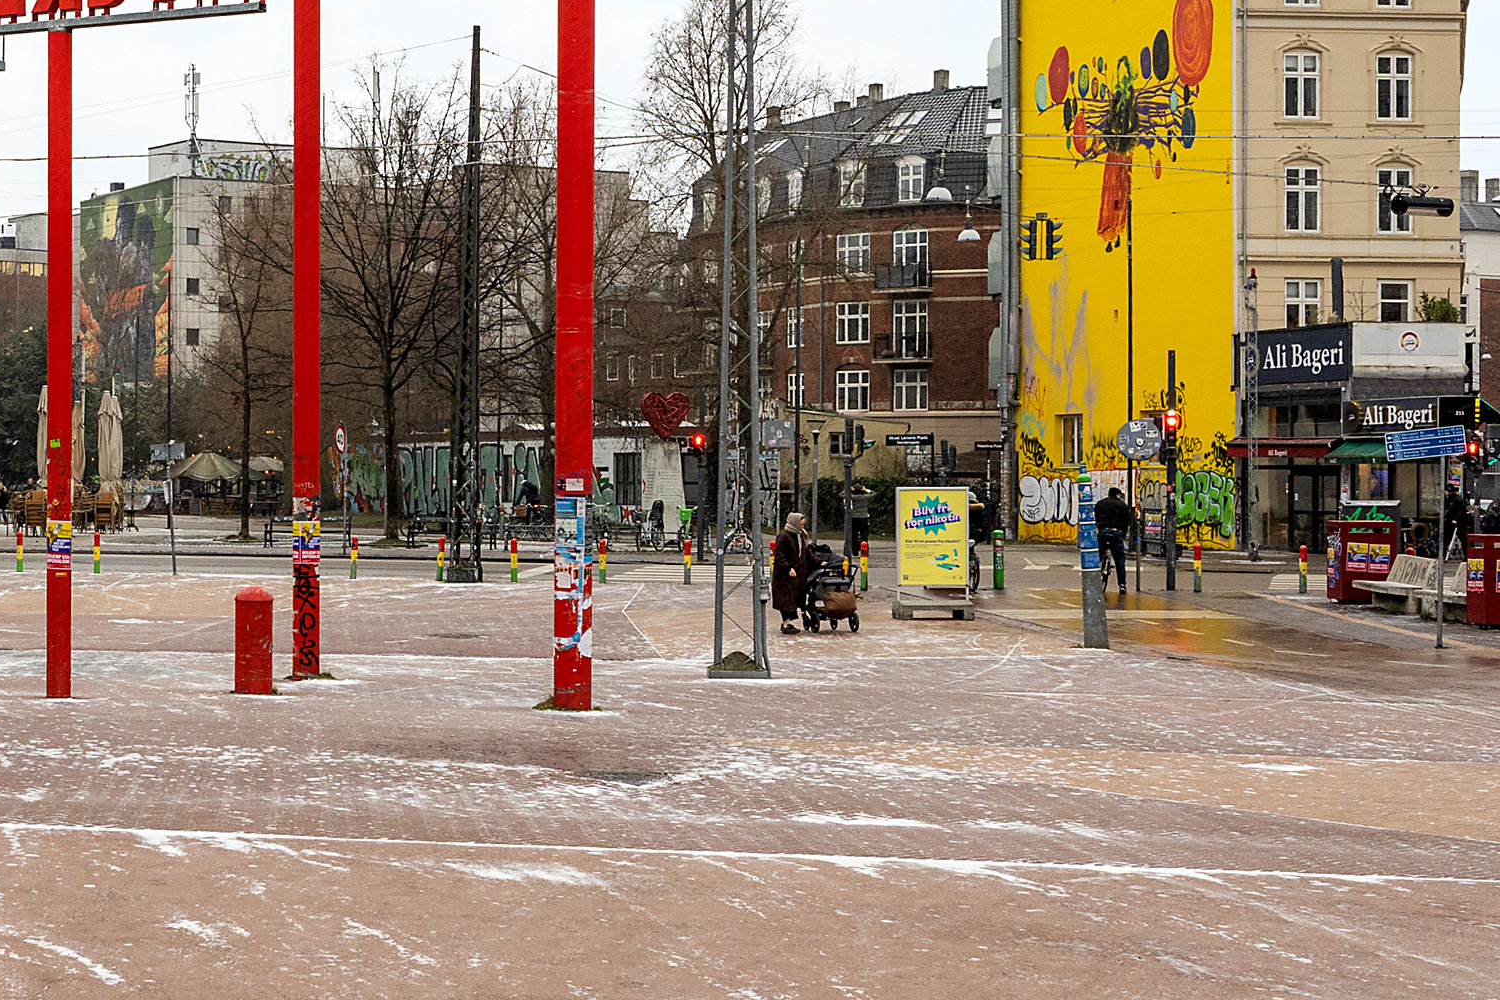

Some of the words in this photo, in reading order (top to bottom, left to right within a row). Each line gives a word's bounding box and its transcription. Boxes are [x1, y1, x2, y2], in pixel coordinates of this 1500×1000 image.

[1263, 344, 1287, 370] Ali
[1291, 341, 1344, 374] Bageri
[1363, 405, 1383, 426] Ali
[1386, 403, 1434, 430] Bageri
[905, 519, 923, 529] for
[924, 512, 962, 526] nikotin
[913, 506, 934, 518] Bliv
[936, 502, 950, 515] fri
